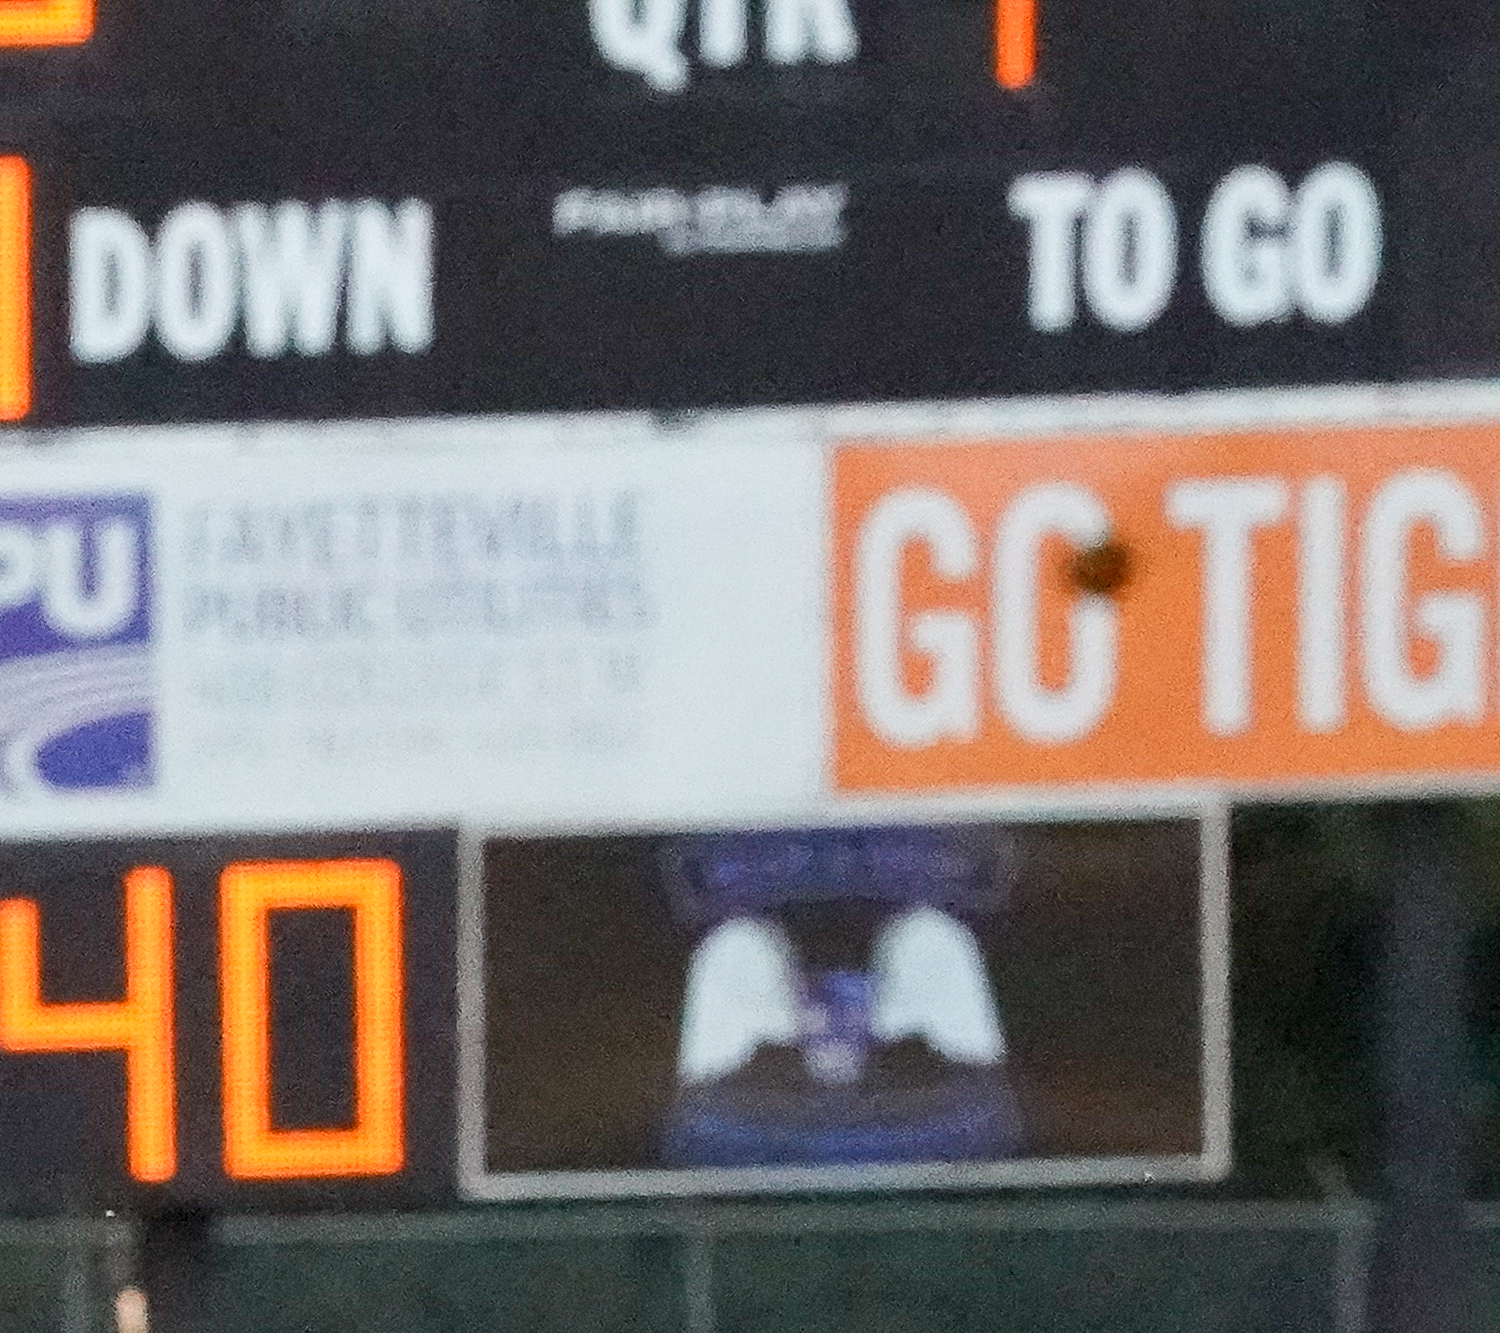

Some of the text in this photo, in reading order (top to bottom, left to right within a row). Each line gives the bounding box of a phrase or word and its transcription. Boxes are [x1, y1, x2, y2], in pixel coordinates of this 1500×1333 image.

[69, 198, 435, 363] DOWN
[1007, 160, 1384, 332] TO GO
